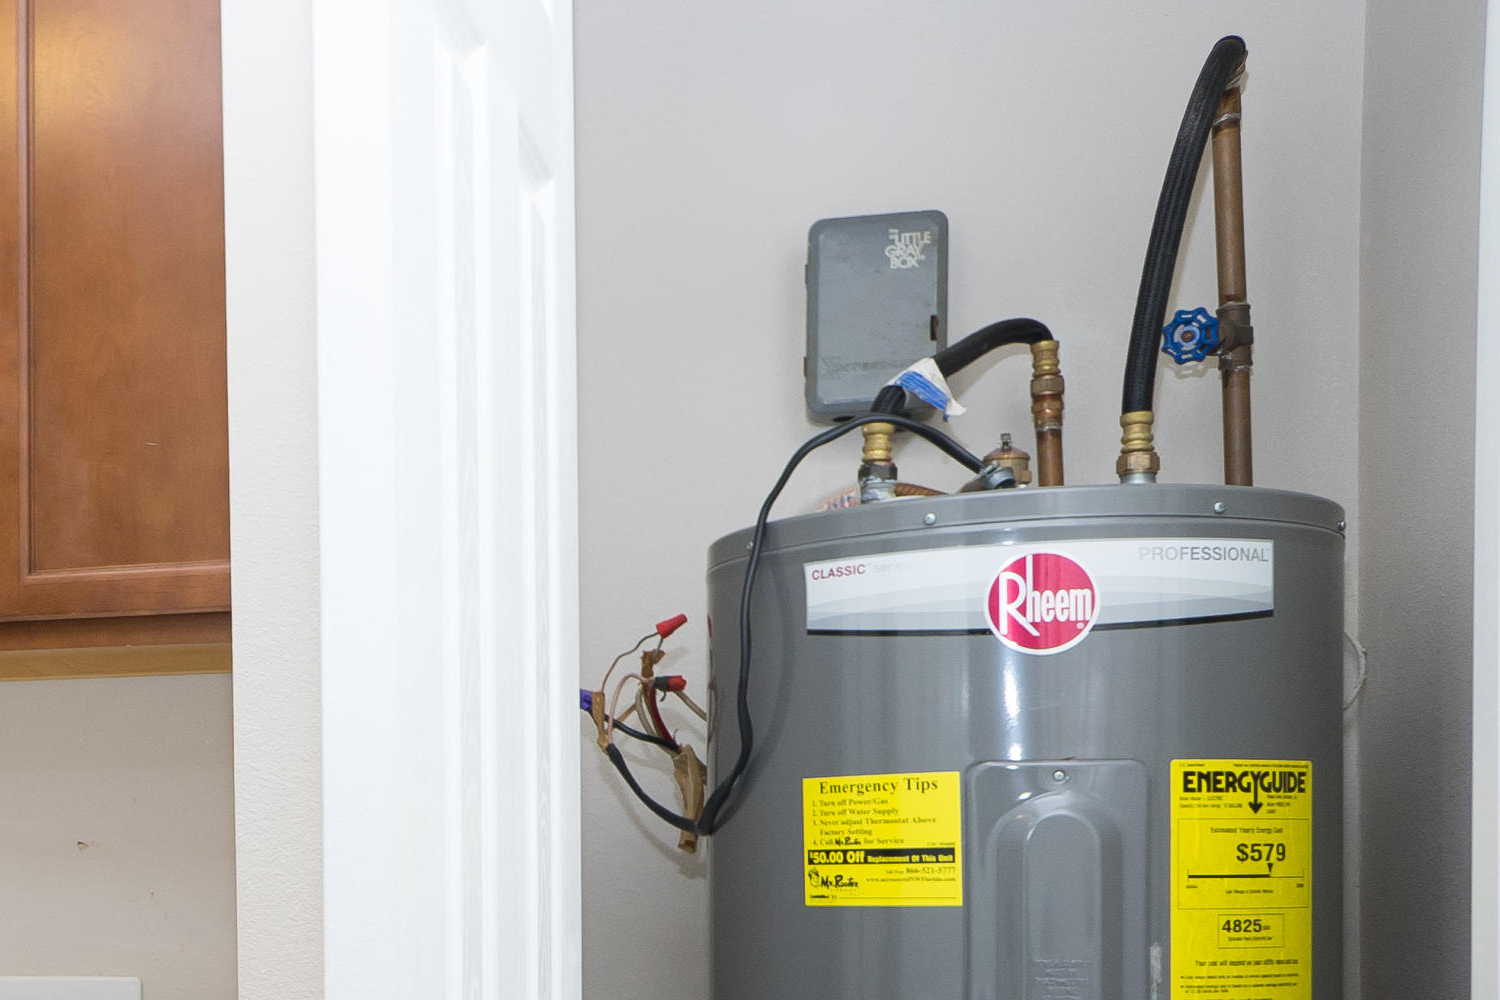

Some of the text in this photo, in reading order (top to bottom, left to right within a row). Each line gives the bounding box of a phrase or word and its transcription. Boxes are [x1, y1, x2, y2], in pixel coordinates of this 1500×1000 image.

[894, 231, 932, 245] LITTLE
[885, 242, 924, 258] GRAY
[890, 256, 919, 269] BOX
[1138, 546, 1268, 562] PROFESSIONAL
[811, 563, 866, 580] CLASSIC
[999, 554, 1093, 637] Rheem
[820, 778, 938, 796] Emergency Tips
[1182, 770, 1307, 793] ENERGYGUIDE
[873, 807, 899, 817] Supply
[841, 819, 863, 828] adjust
[865, 817, 909, 825] Thermostat
[912, 816, 937, 824] Above
[820, 828, 873, 837] Factory Setting
[820, 838, 834, 846] Call
[864, 837, 874, 845] for
[876, 837, 905, 845] Service
[846, 850, 865, 863] Off
[1237, 843, 1286, 863] $579
[1222, 919, 1262, 934] 4825
